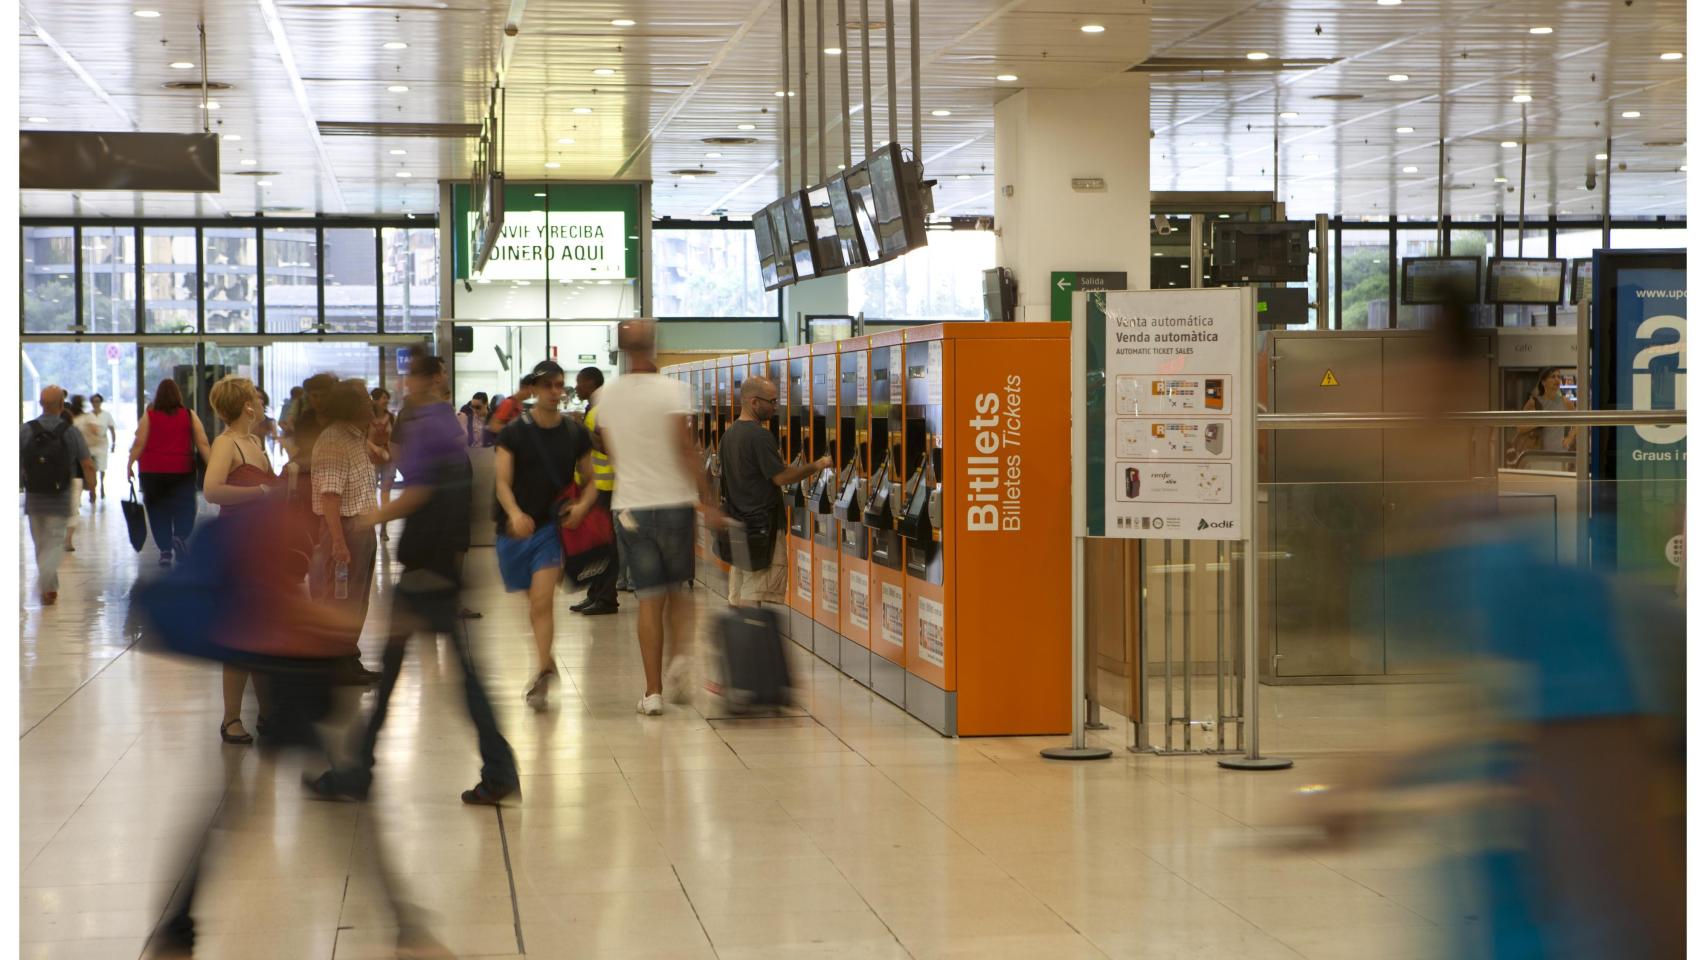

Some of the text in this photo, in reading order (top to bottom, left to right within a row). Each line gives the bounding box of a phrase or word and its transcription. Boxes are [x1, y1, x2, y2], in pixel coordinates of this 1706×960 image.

[536, 225, 546, 239] Y
[550, 225, 605, 239] RECIBA
[489, 245, 555, 261] DINERO
[1081, 277, 1104, 285] Salida
[1116, 315, 1214, 327] Venta automática
[1116, 331, 1219, 343] Venda automàtica
[1002, 374, 1021, 531] Billetes Tickets
[1632, 449, 1672, 461] Graus
[967, 392, 1000, 531] Bitllets
[1210, 520, 1234, 529] adif
